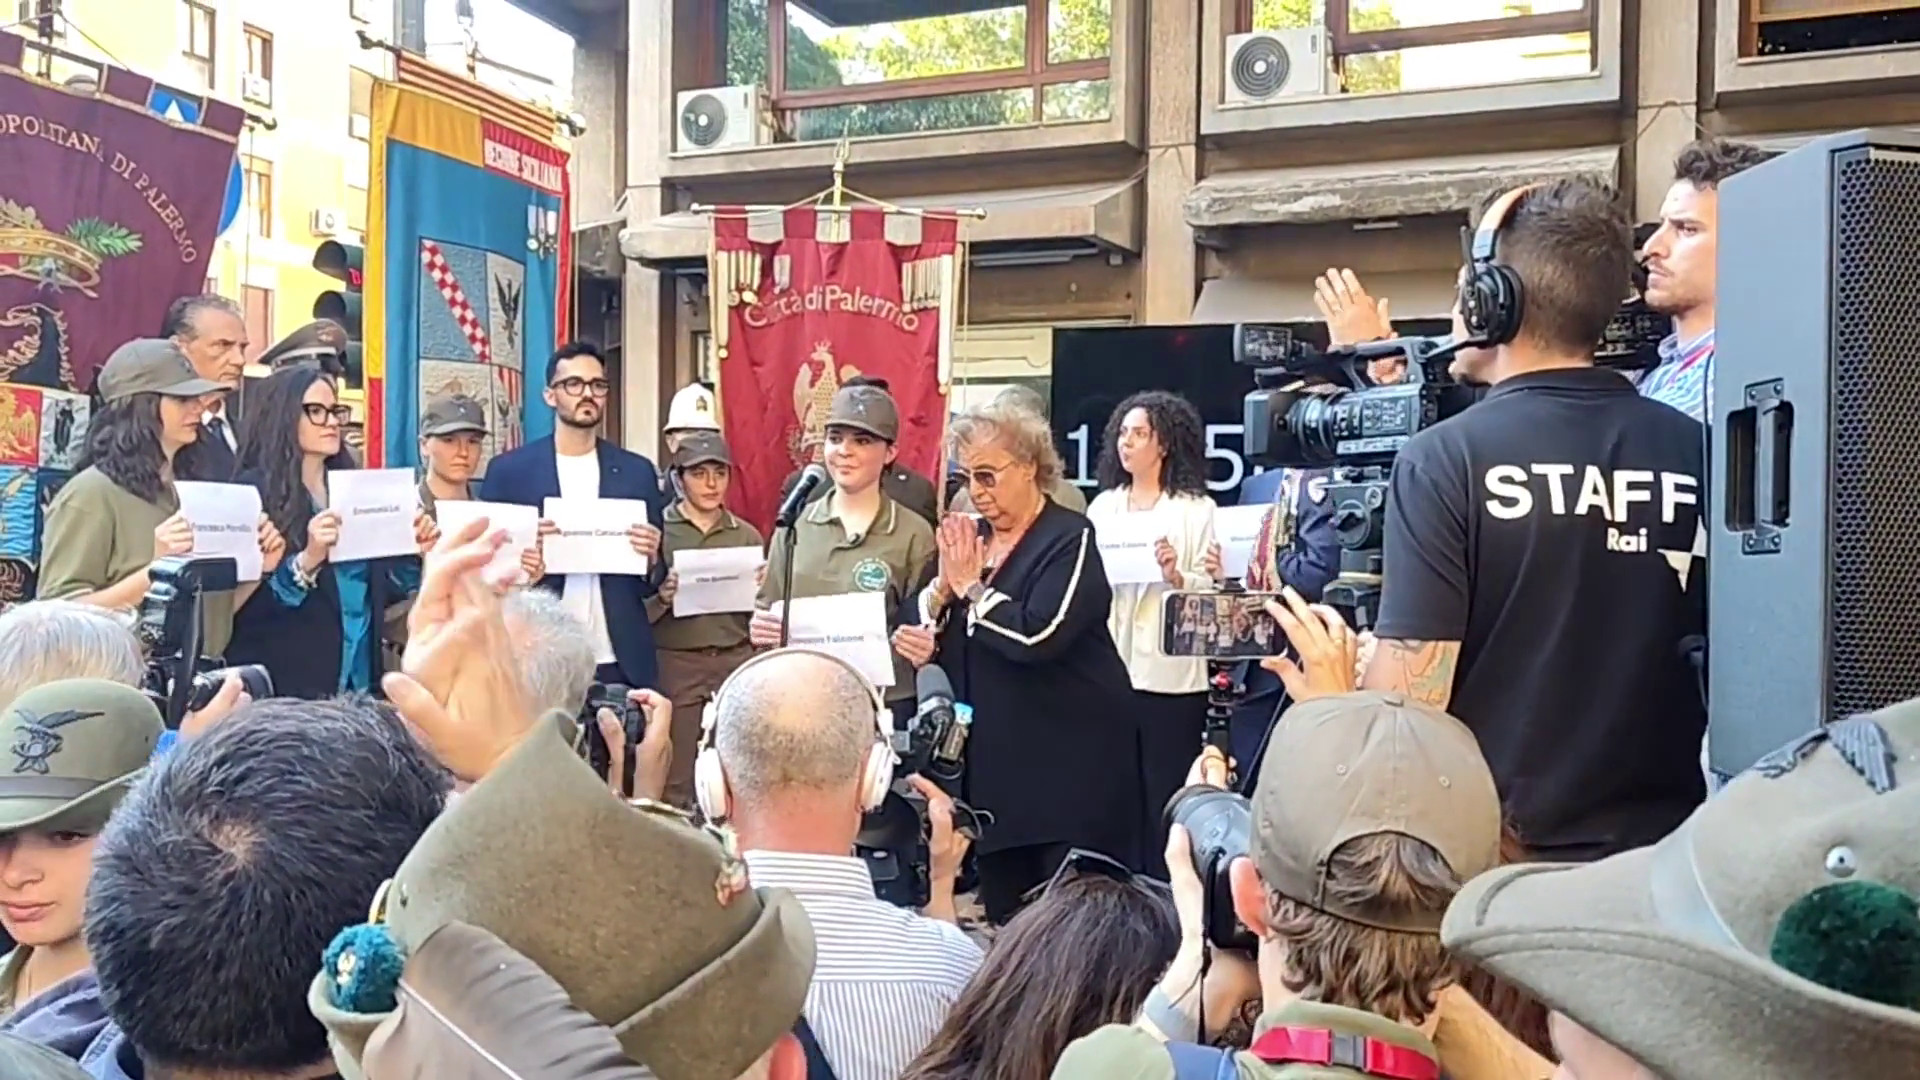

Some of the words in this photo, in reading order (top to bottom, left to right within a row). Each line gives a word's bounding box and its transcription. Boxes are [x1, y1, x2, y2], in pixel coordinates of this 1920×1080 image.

[110, 152, 137, 179] DI
[134, 175, 197, 263] PALERMO
[804, 284, 822, 310] di
[825, 284, 919, 331] Palermo
[1484, 463, 1697, 523] STAFF
[1606, 527, 1649, 552] Rai
